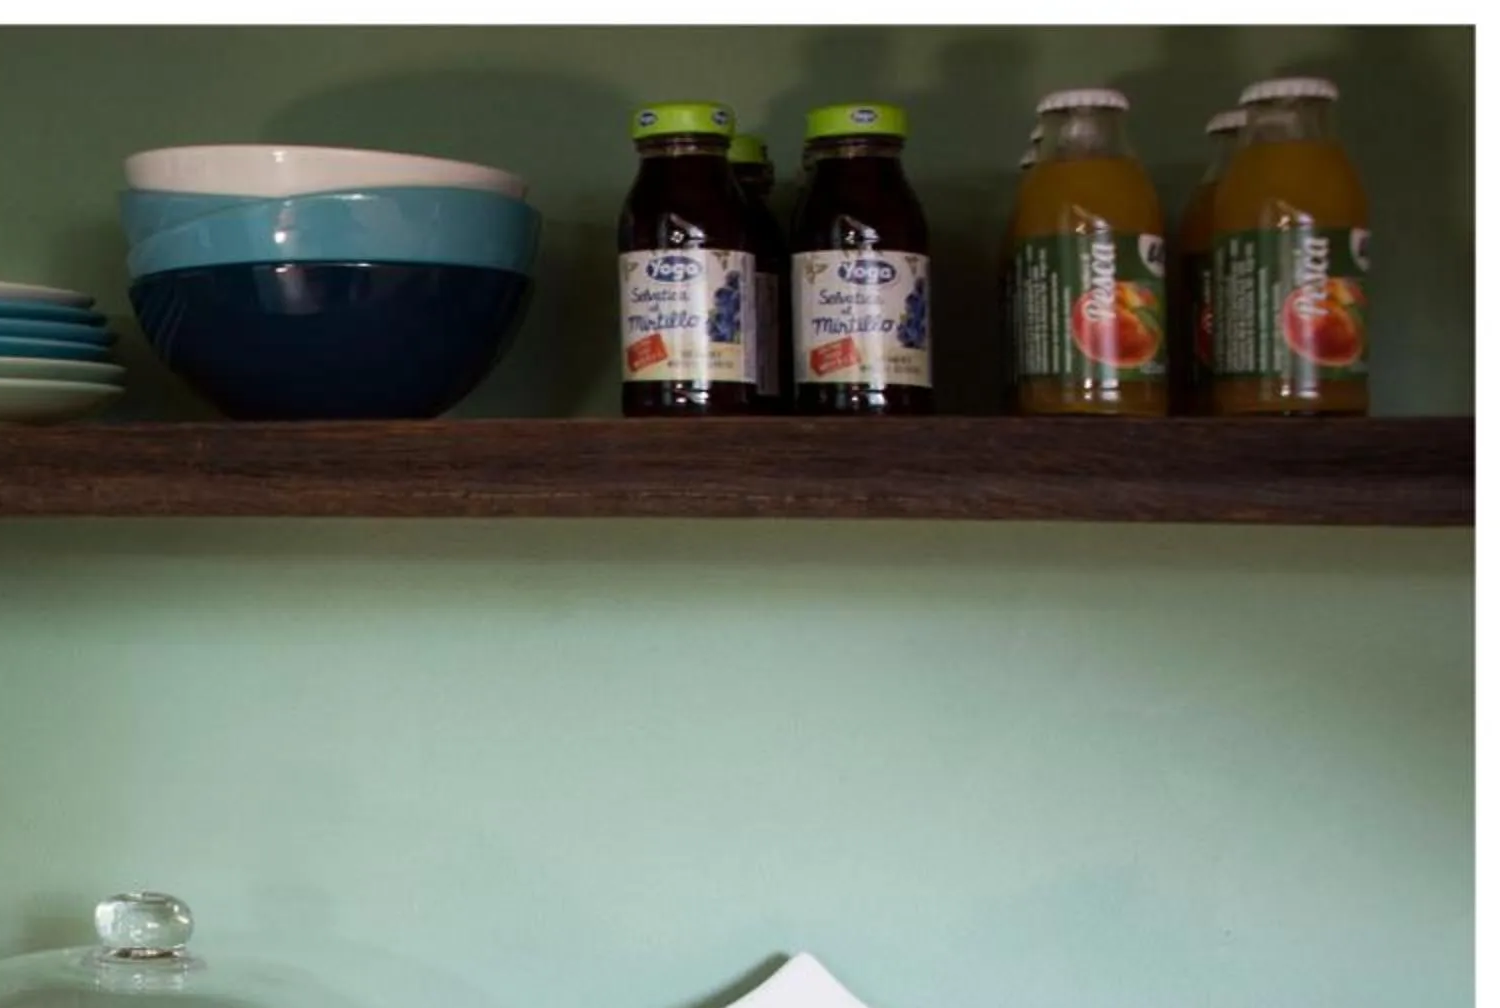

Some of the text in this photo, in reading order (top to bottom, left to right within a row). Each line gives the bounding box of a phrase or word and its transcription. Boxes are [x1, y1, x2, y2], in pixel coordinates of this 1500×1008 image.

[650, 258, 700, 281] Yoga
[845, 261, 894, 284] Yoga
[1080, 243, 1117, 322] Pesca
[627, 311, 700, 334] Mirtillo
